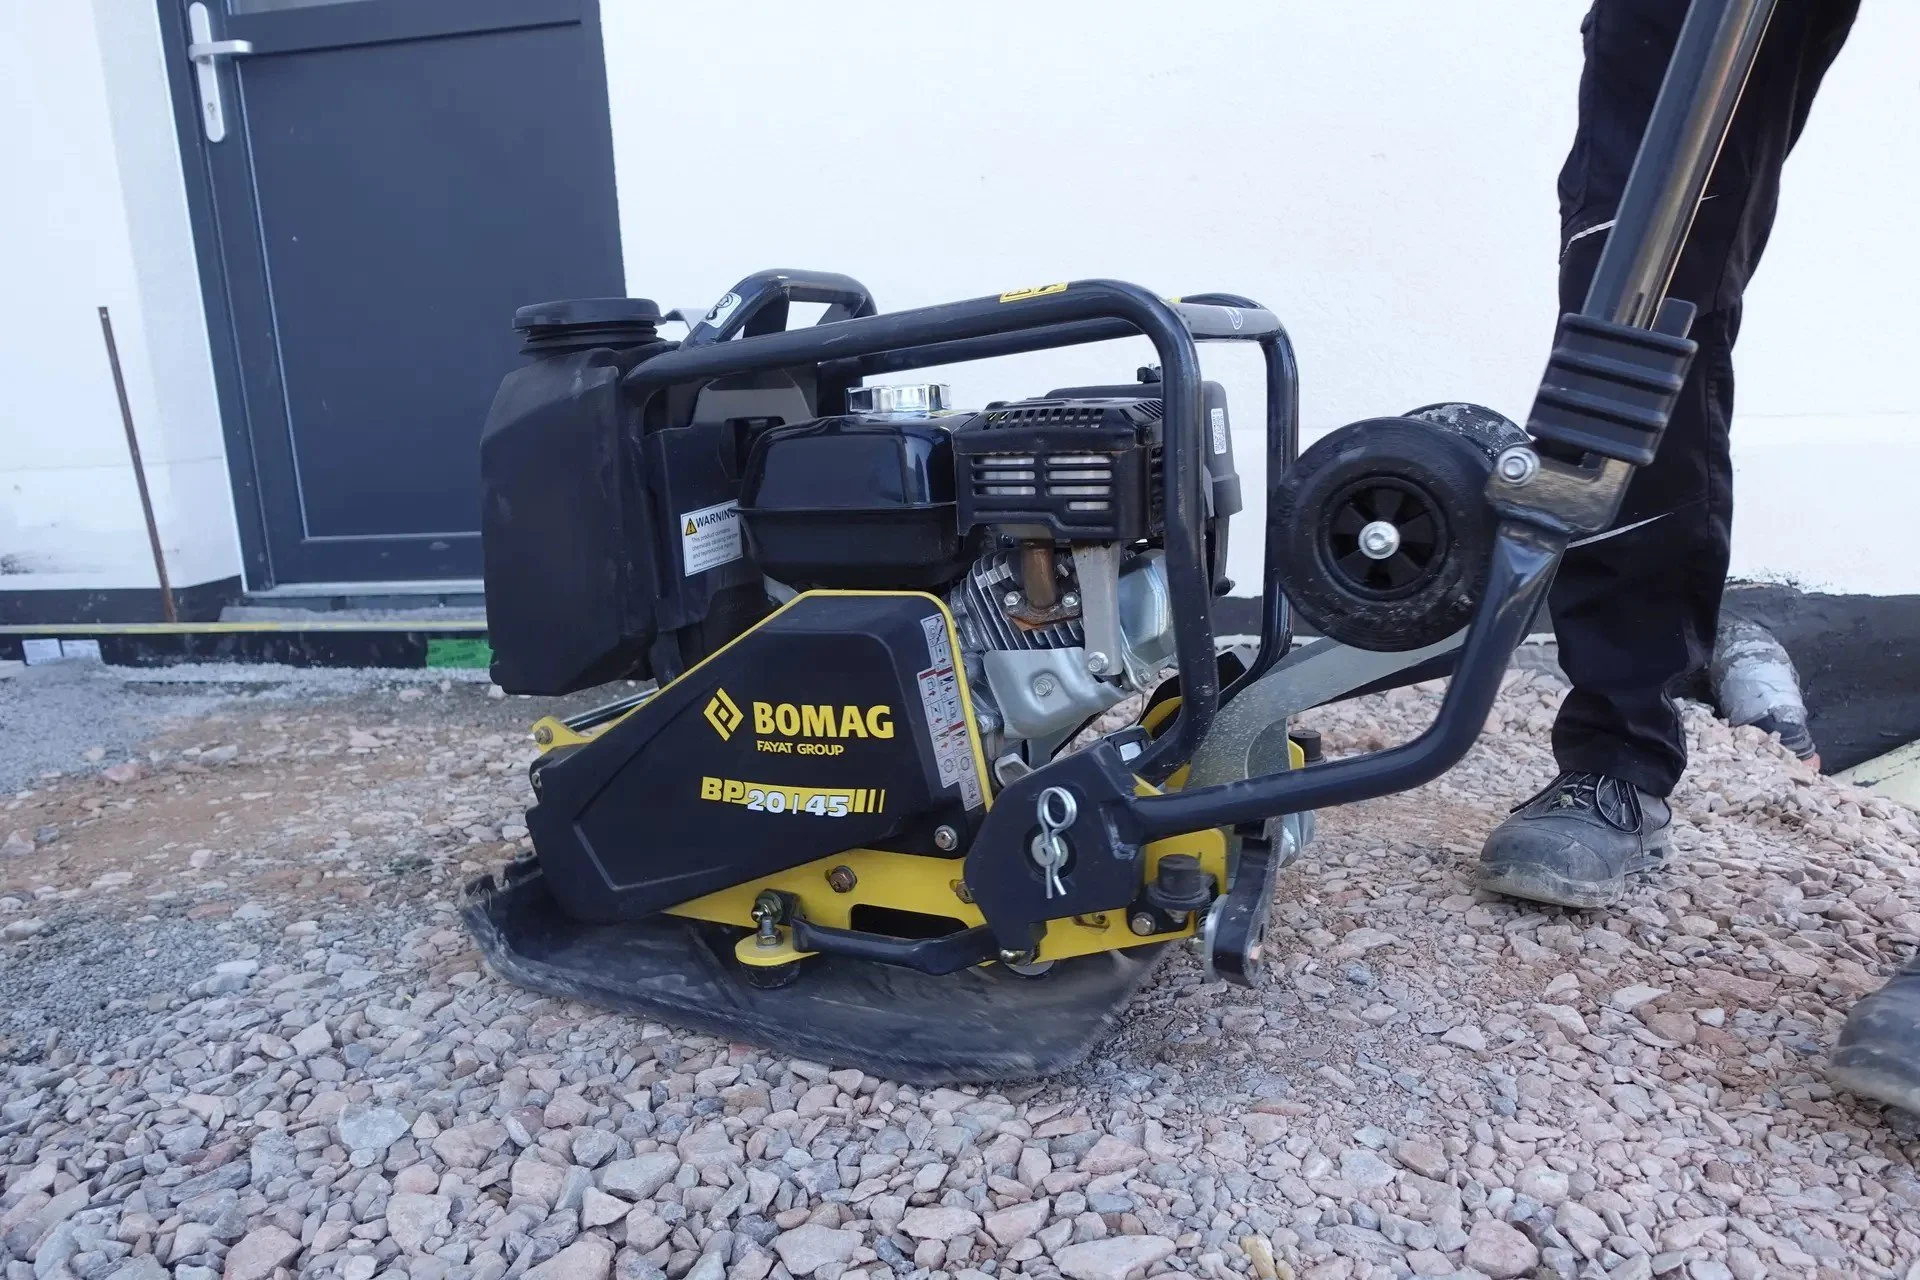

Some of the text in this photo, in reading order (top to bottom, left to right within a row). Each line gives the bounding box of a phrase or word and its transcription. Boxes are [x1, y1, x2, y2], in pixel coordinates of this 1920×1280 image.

[752, 701, 895, 739] BOMAG
[756, 740, 844, 756] FAYAT GROUP
